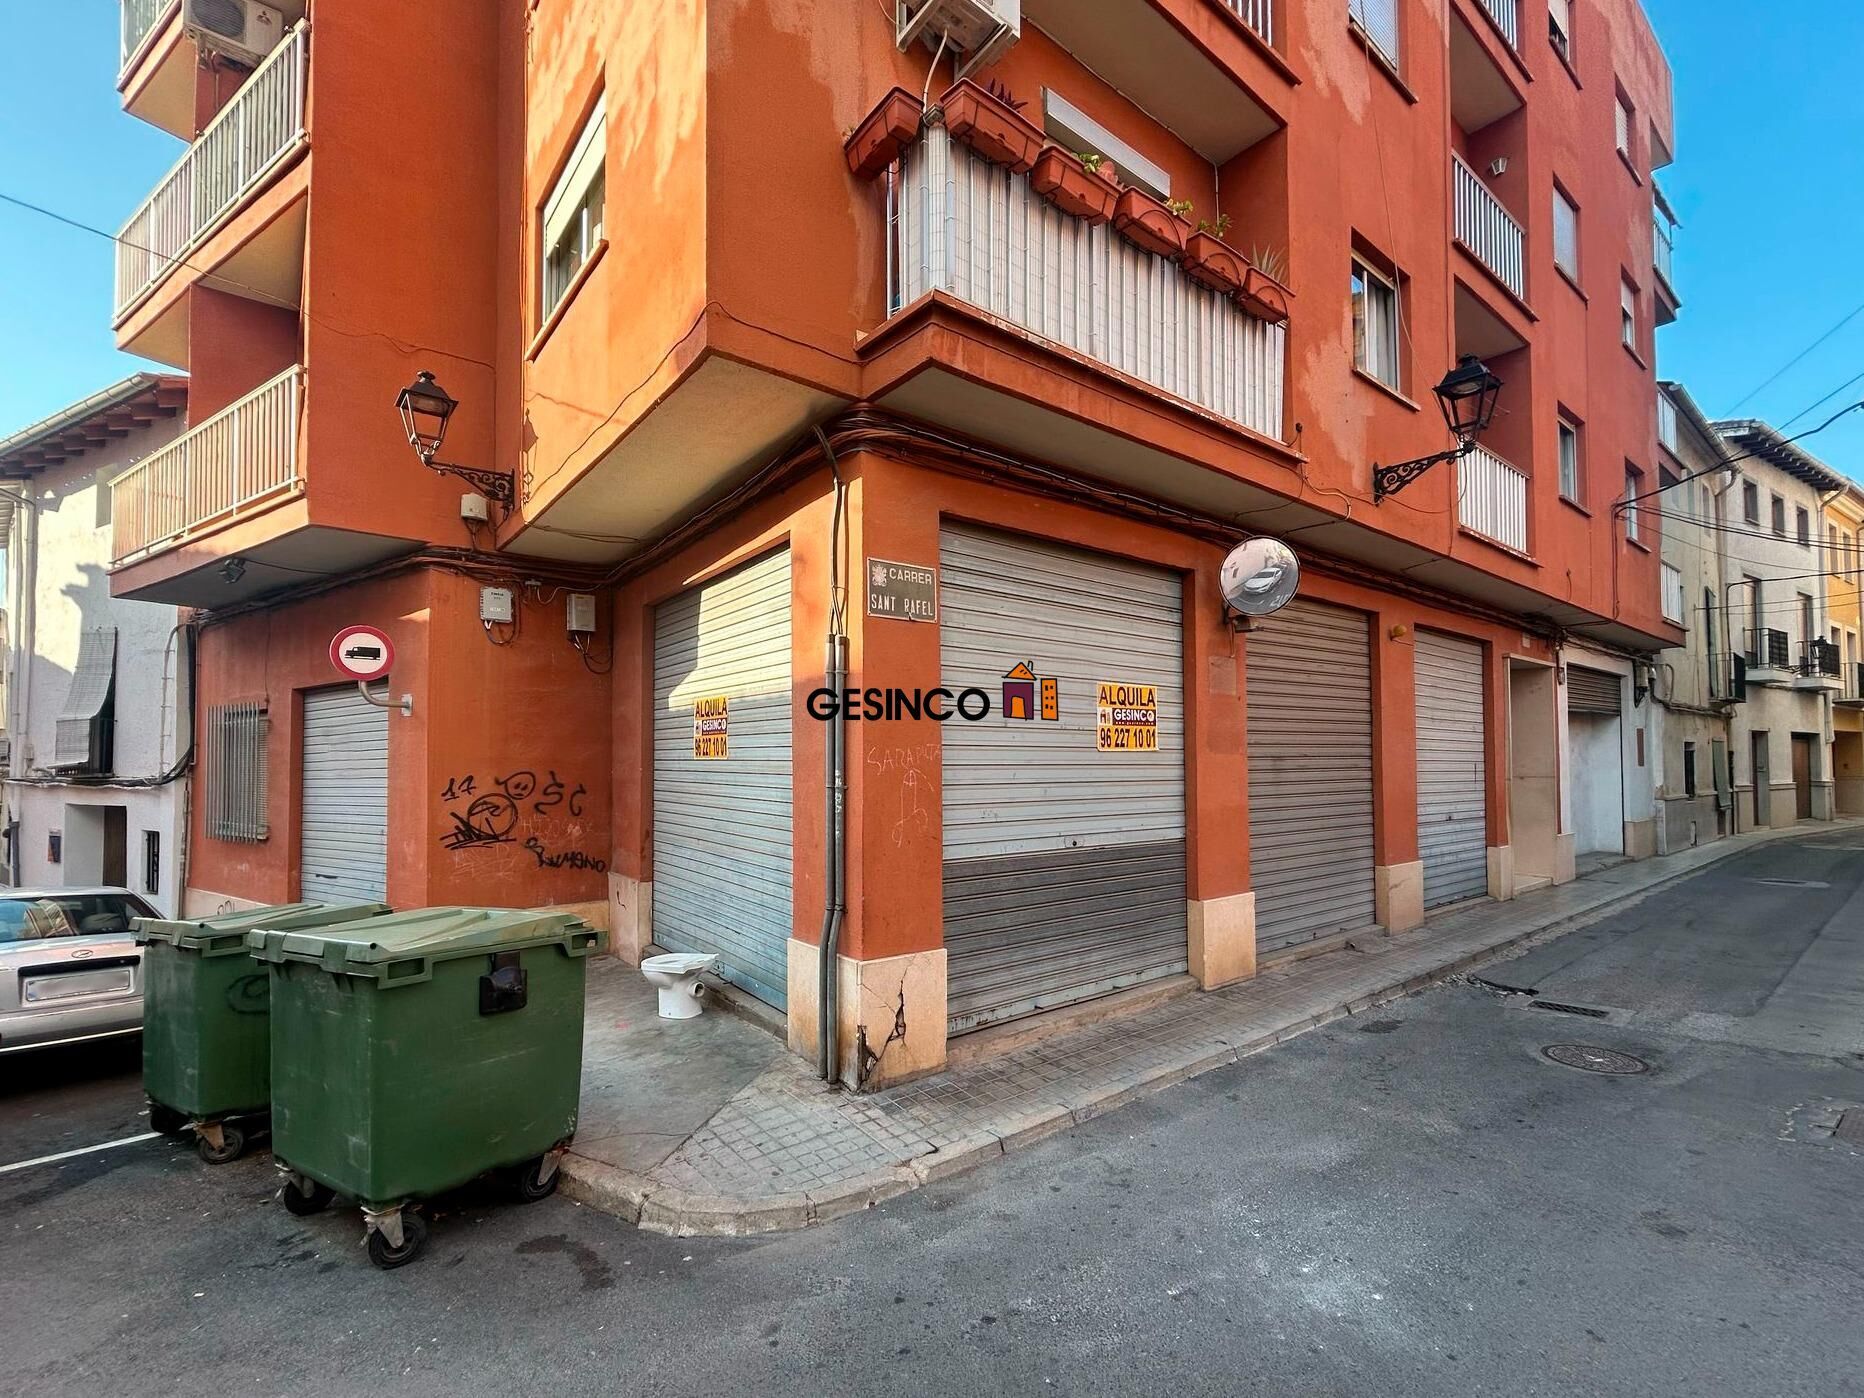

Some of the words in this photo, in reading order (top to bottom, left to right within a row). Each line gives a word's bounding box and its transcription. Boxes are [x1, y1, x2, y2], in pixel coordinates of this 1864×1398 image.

[889, 568, 932, 585] CARRER
[871, 593, 896, 612] SANT
[904, 598, 934, 616] RAFEL
[1099, 686, 1156, 707] ALQUILA
[695, 698, 727, 717] ALQUILA
[1114, 709, 1154, 722] GESINCO
[702, 719, 727, 731] GESINCO
[695, 737, 701, 756] 96
[702, 737, 711, 756] 227
[713, 737, 720, 756] 10
[721, 737, 727, 756] 01
[1100, 728, 1112, 748] 96
[1115, 728, 1130, 748] 227
[1133, 728, 1144, 748] 10
[1146, 728, 1156, 748] 01
